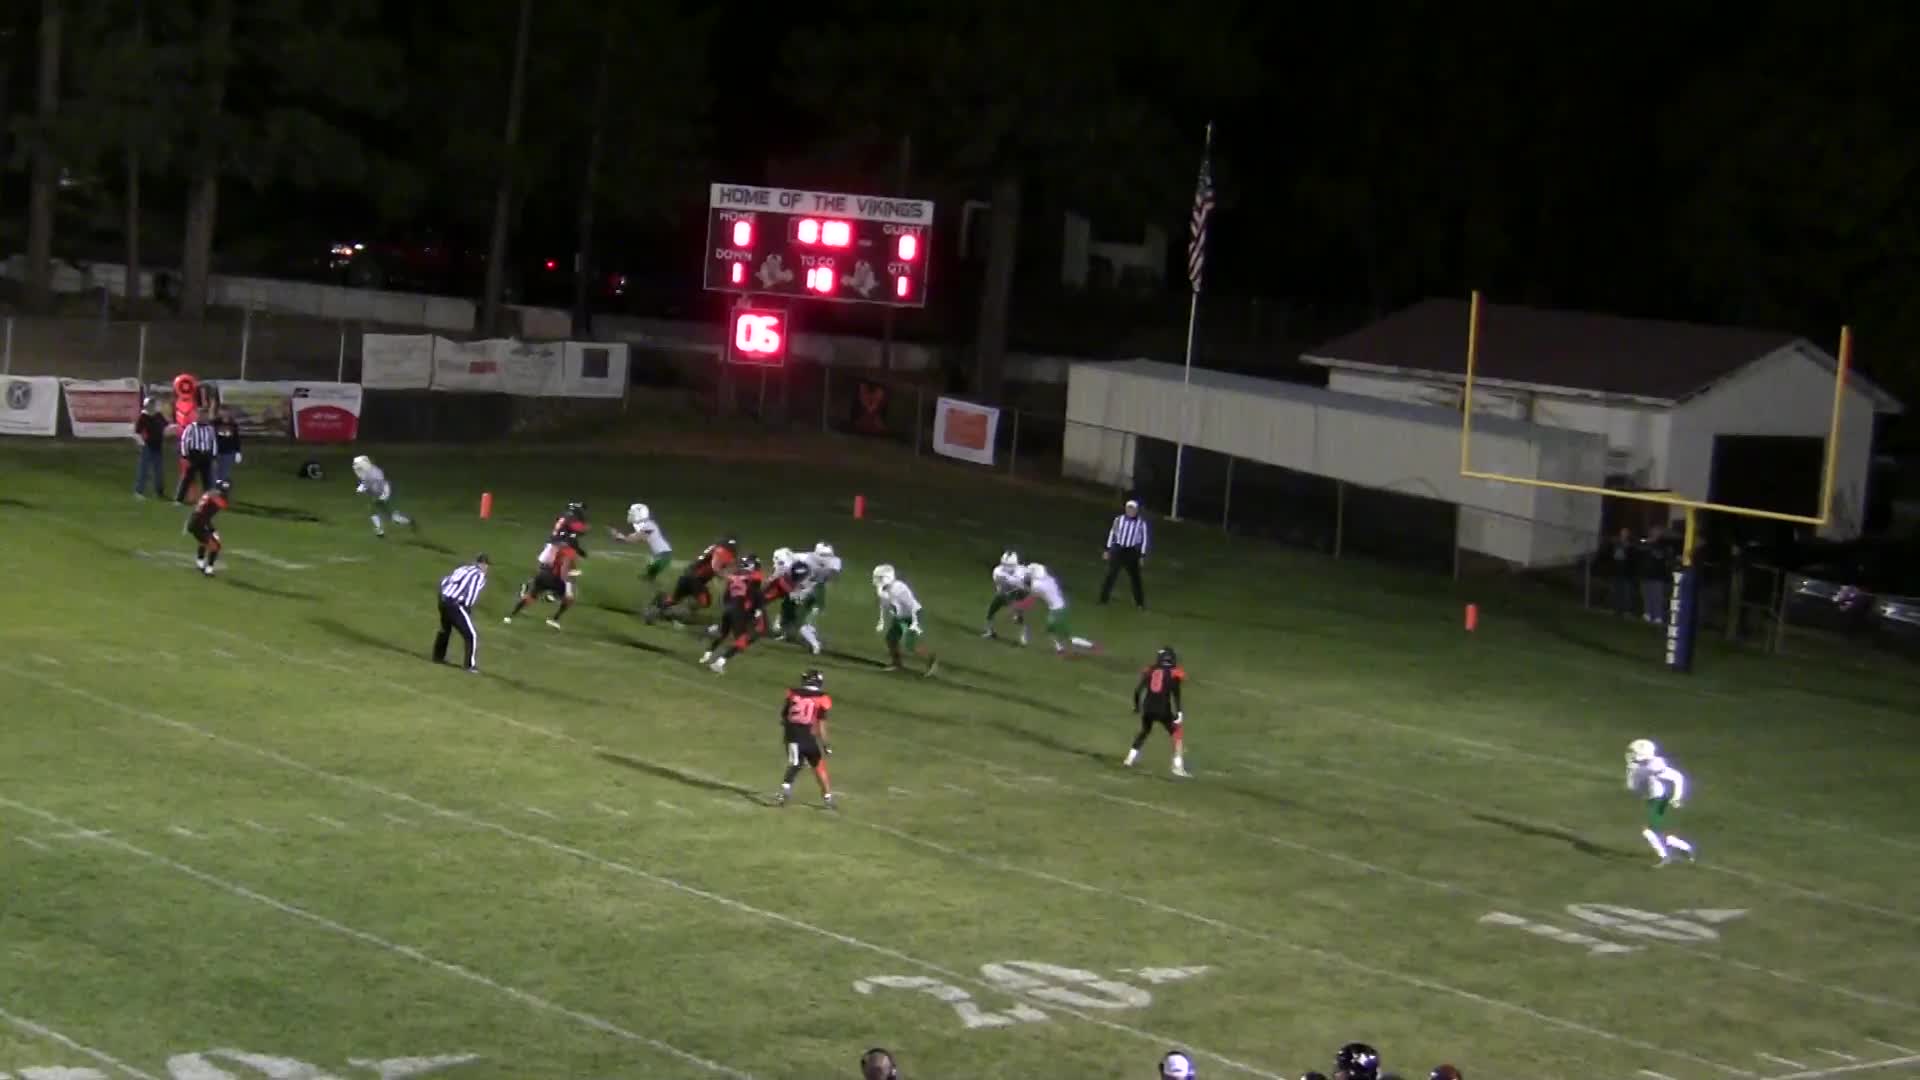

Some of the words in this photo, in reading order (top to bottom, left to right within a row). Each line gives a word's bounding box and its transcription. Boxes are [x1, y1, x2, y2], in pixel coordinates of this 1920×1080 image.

[720, 187, 770, 206] HOME
[779, 191, 802, 208] OF
[814, 195, 846, 212] THE
[856, 198, 924, 218] VIKINGS
[715, 248, 753, 262] DOWN
[801, 255, 816, 267] TO
[732, 262, 743, 284] 1
[897, 275, 908, 297] 1
[852, 960, 1152, 1028] 20
